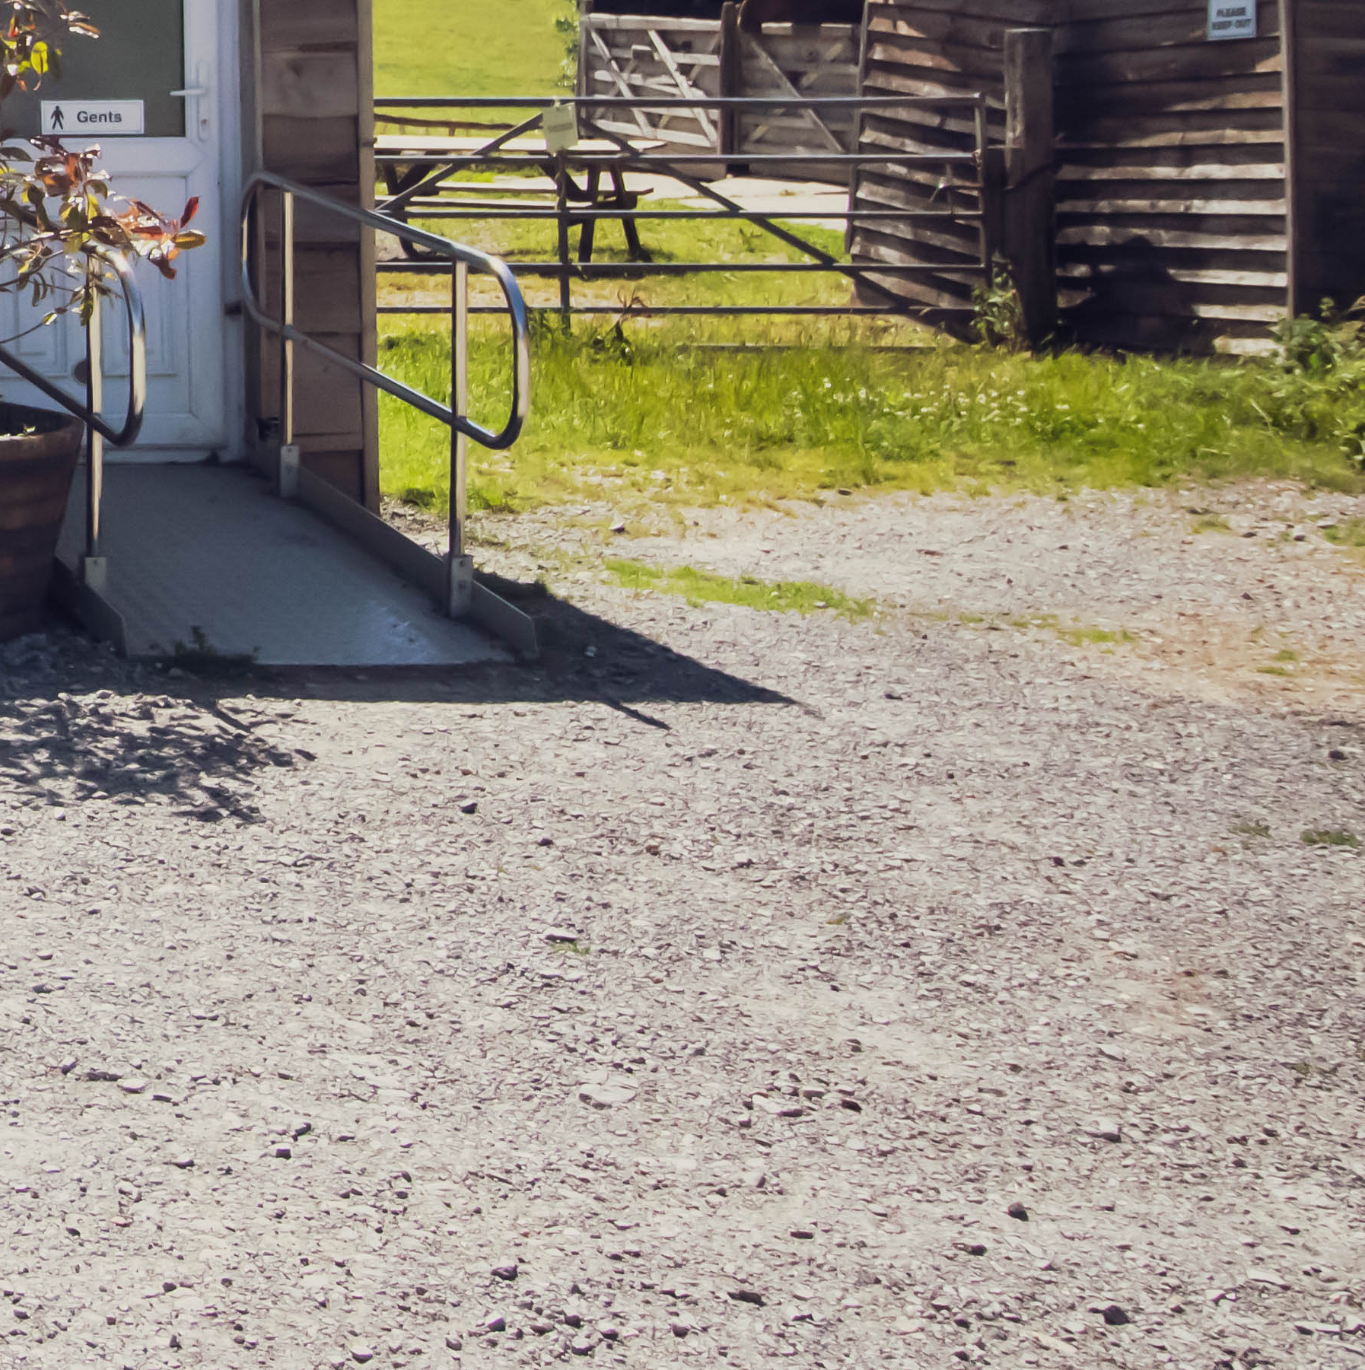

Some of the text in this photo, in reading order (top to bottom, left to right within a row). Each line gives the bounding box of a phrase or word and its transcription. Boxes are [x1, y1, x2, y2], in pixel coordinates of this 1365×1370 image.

[1216, 6, 1246, 17] PLEASE
[1234, 18, 1252, 28] OUT
[76, 110, 122, 123] Gents
